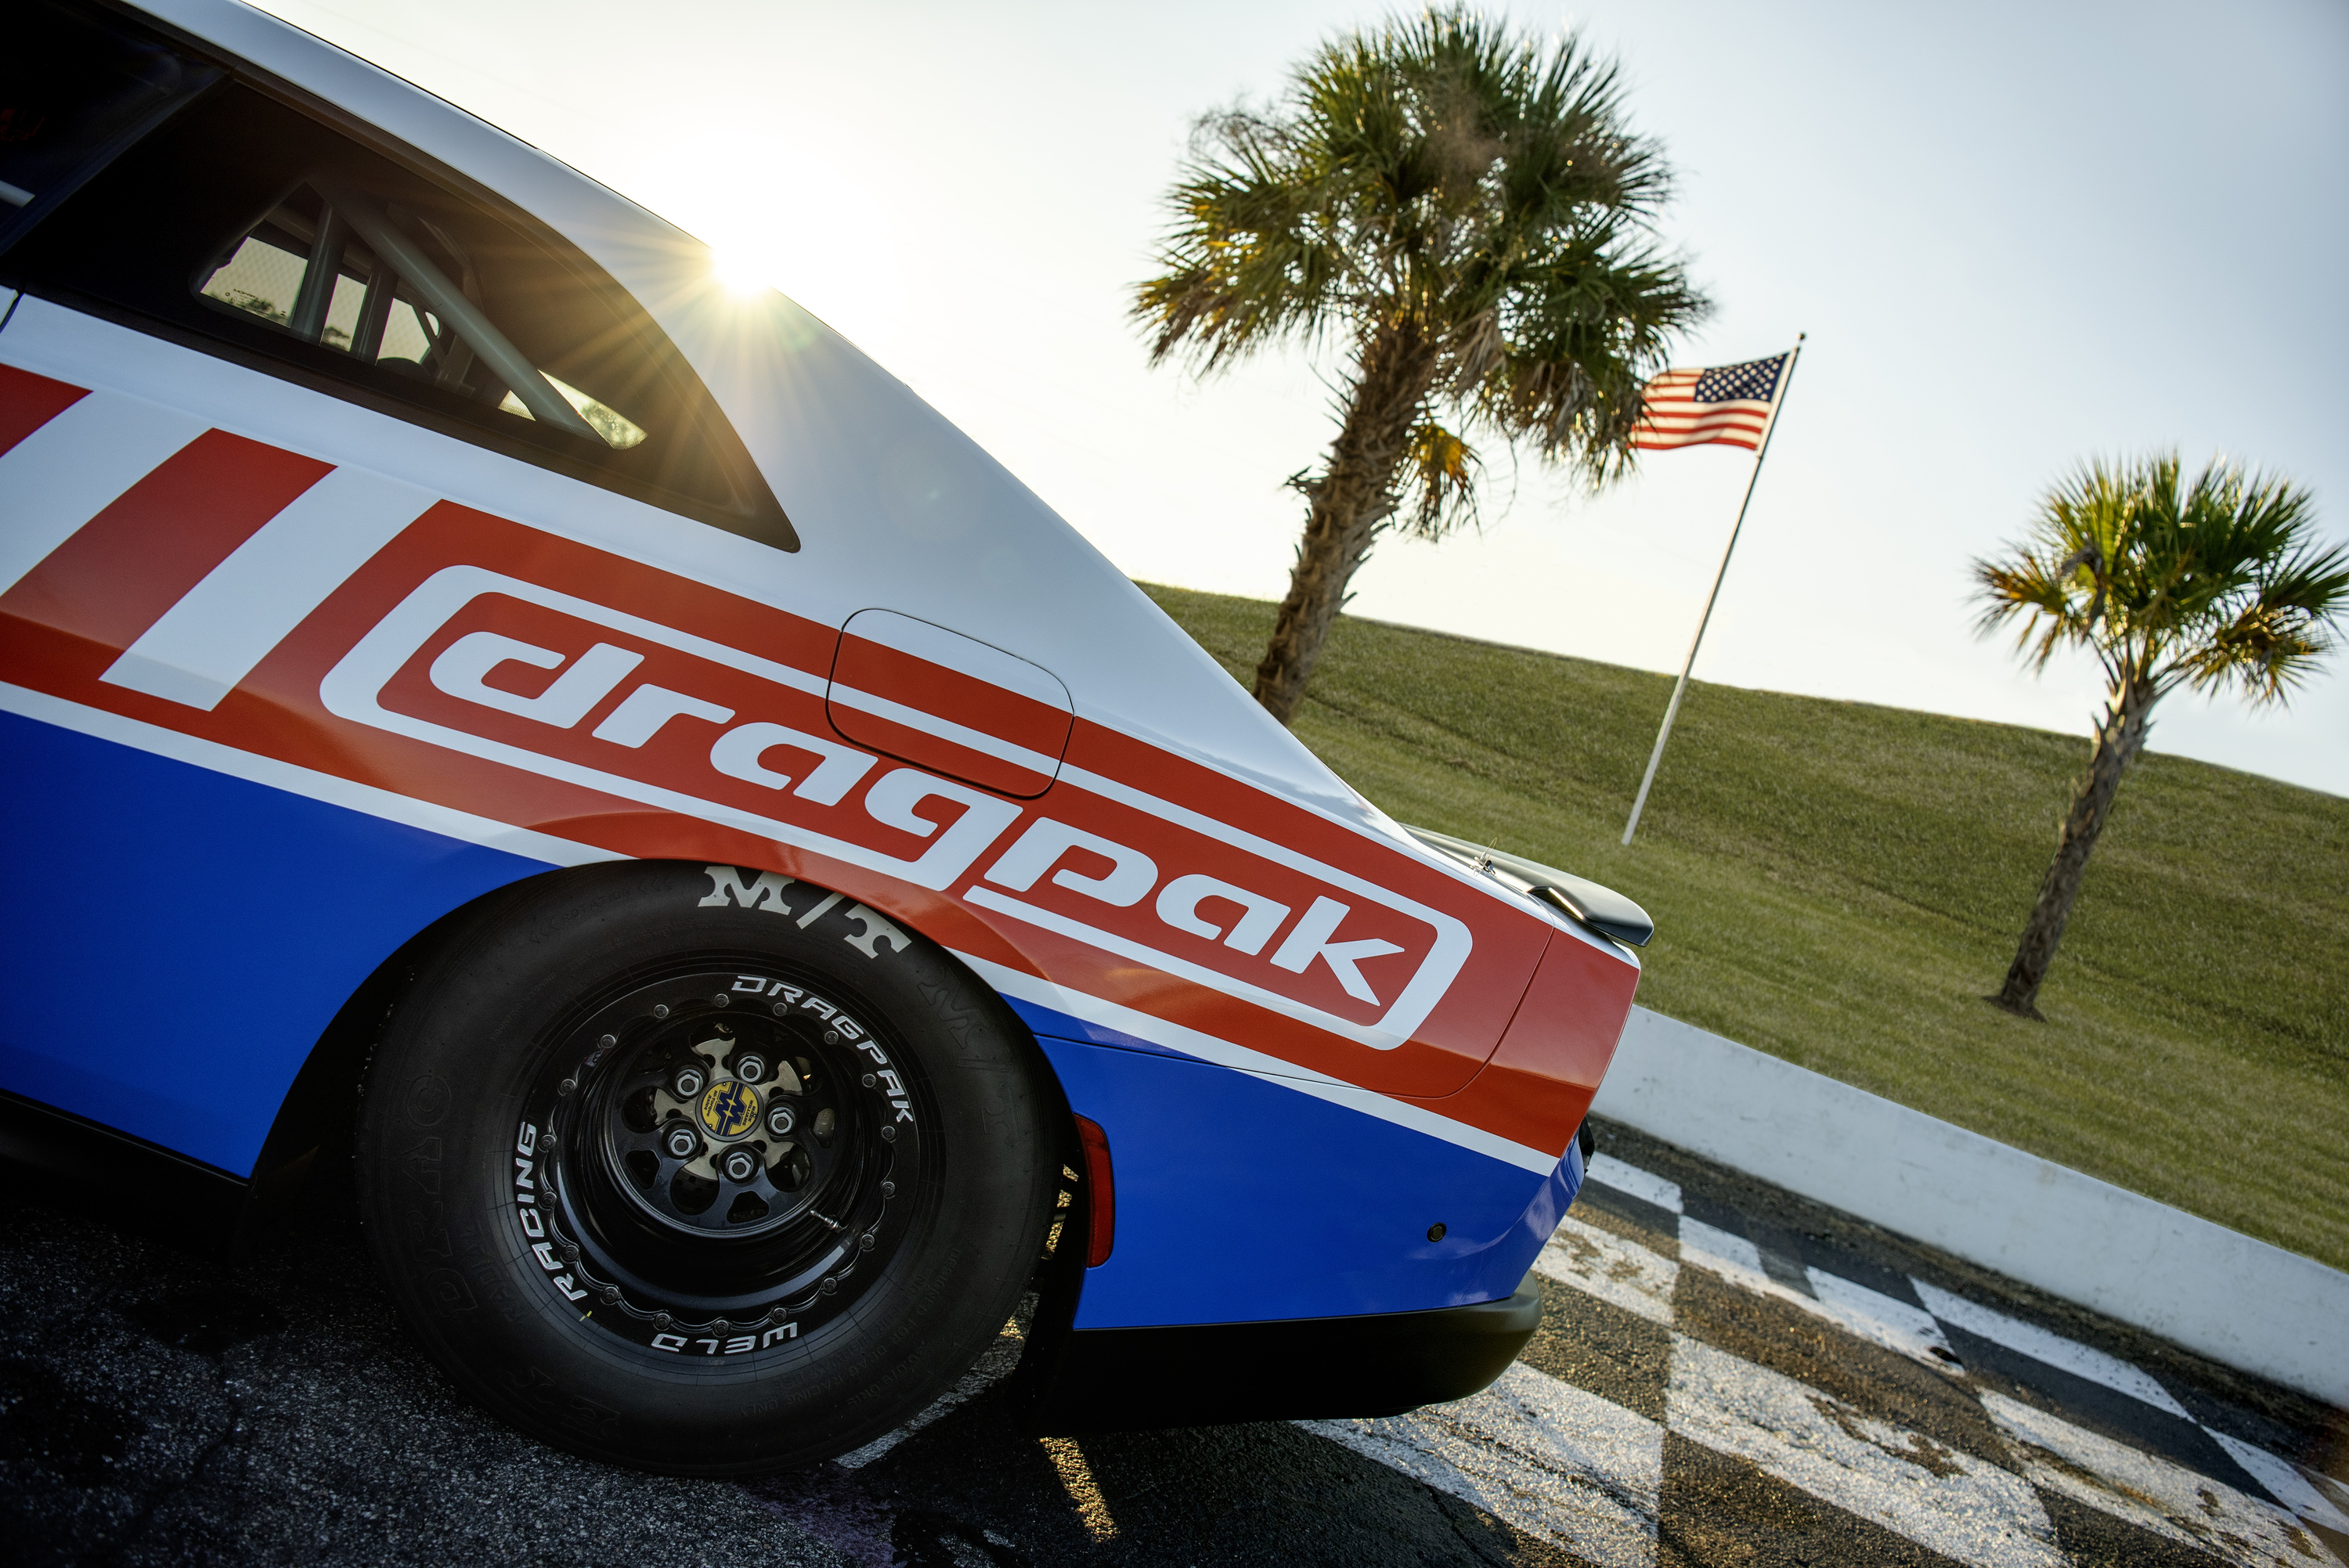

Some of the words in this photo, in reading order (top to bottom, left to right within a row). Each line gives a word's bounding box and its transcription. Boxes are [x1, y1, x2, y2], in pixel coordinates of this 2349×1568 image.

[430, 630, 1405, 1006] dragpak
[698, 866, 911, 959] M/T
[731, 975, 916, 1124] DRAGPAK
[742, 1100, 753, 1126] WILLIAMS
[515, 1122, 587, 1302] RACING
[651, 1321, 798, 1354] WELD
